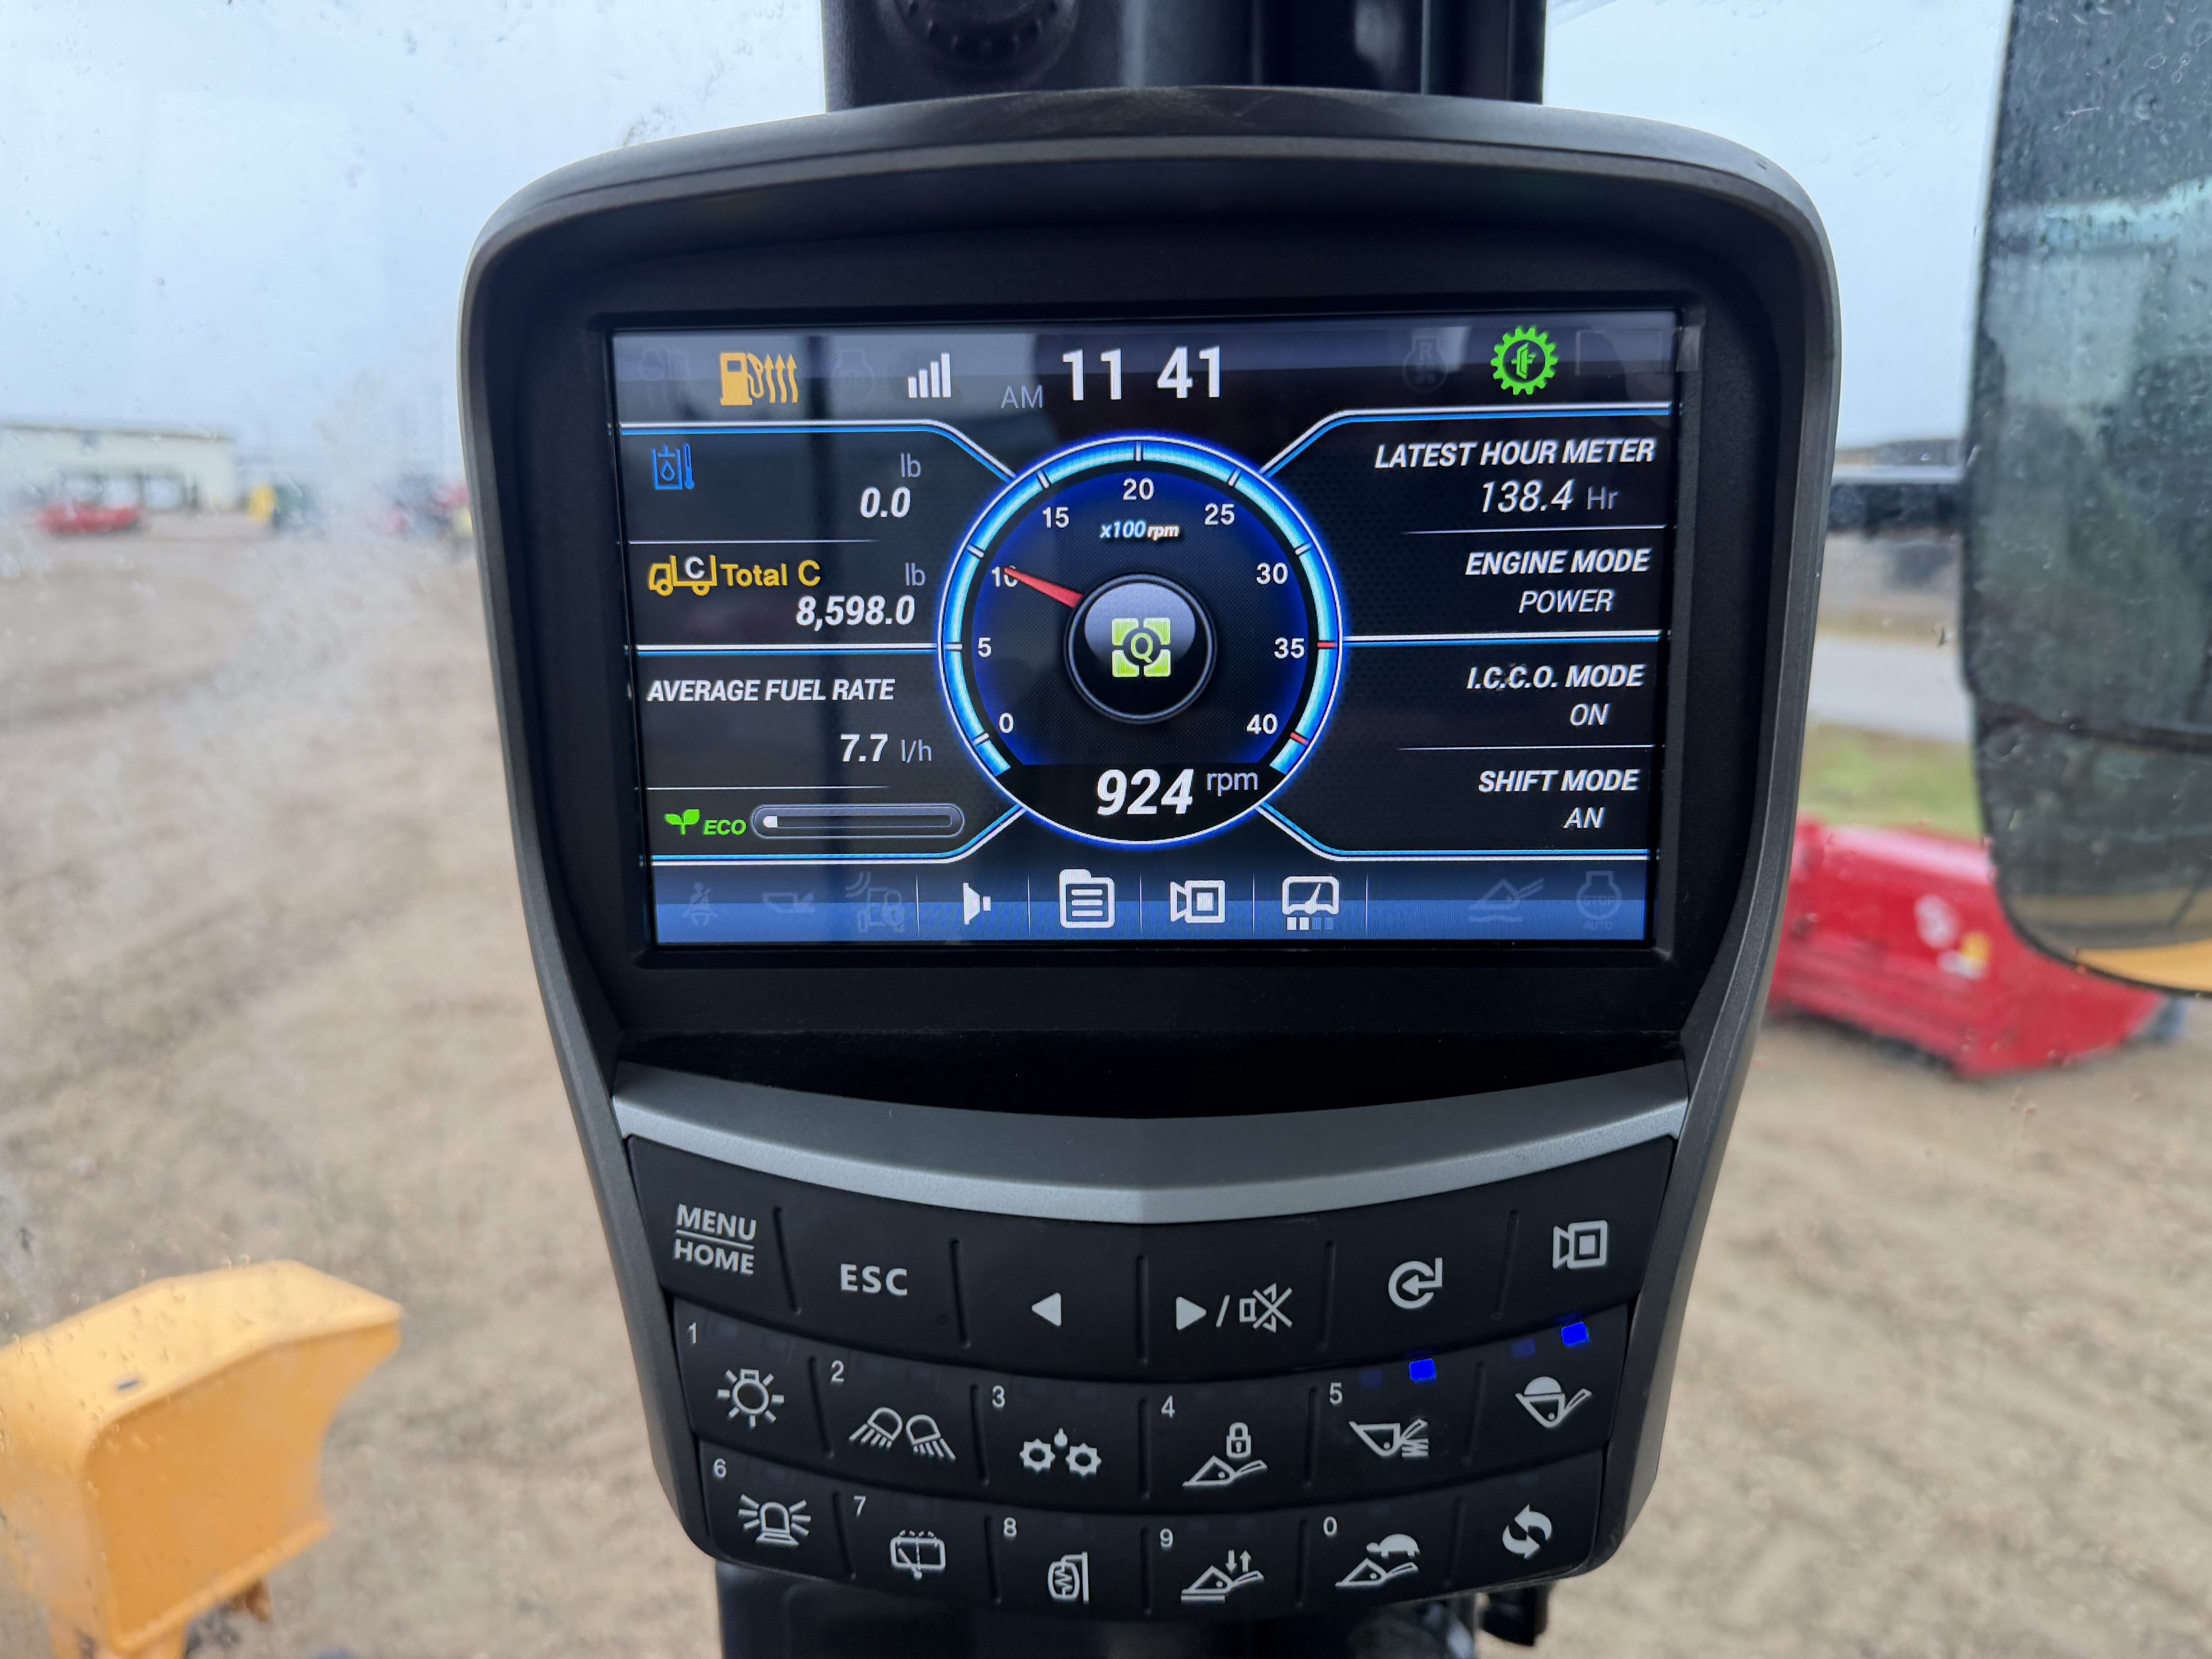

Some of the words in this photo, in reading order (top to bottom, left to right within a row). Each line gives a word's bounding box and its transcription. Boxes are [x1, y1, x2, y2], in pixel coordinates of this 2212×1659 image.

[1001, 385, 1043, 409] AM
[1375, 442, 1477, 468] LATEST
[1480, 440, 1557, 465] HOUR
[1561, 438, 1654, 463] METER
[901, 453, 921, 477] lb
[1123, 478, 1154, 500] 20
[1482, 479, 1573, 512] 138.4
[1587, 487, 1618, 510] Hr
[860, 487, 910, 518] 0.0
[1204, 503, 1235, 525] 25
[1042, 507, 1069, 528] 15
[721, 564, 788, 587] Total
[798, 560, 821, 586] C
[1256, 562, 1288, 585] 30
[1465, 550, 1565, 575] ENGINE
[1570, 549, 1650, 573] MODE
[905, 563, 925, 586] lb
[1519, 589, 1613, 613] POWER
[796, 595, 915, 632] 8,598.0
[978, 637, 991, 658] 5
[1274, 637, 1304, 659] 35
[1467, 666, 1557, 689] I.C.C.O.
[1565, 664, 1644, 687] MODE
[646, 680, 761, 701] AVERAGE
[765, 679, 826, 701] FUEL
[832, 678, 895, 700] RATE
[999, 713, 1013, 733] 0
[1247, 713, 1278, 734] 40
[1570, 704, 1608, 726] ON
[840, 733, 888, 762] 7.7
[901, 739, 932, 763] l/h
[1478, 770, 1558, 792] SHIFT
[1560, 769, 1638, 791] MODE
[1097, 769, 1194, 816] 924
[1207, 772, 1258, 797] rpm
[703, 819, 746, 835] ECO
[1563, 807, 1604, 828] AN
[676, 1204, 756, 1240] MENU
[674, 1238, 754, 1275] HOME
[840, 1264, 908, 1296] ESC
[689, 1322, 696, 1344] 1
[831, 1360, 844, 1382] 2
[992, 1385, 1005, 1408] 3
[1329, 1382, 1343, 1405] 5
[1161, 1396, 1175, 1418] 4
[714, 1458, 726, 1478] 6
[854, 1496, 866, 1516] 7
[1003, 1517, 1017, 1537] 8
[1323, 1516, 1337, 1536] 0
[1160, 1528, 1173, 1548] 9
